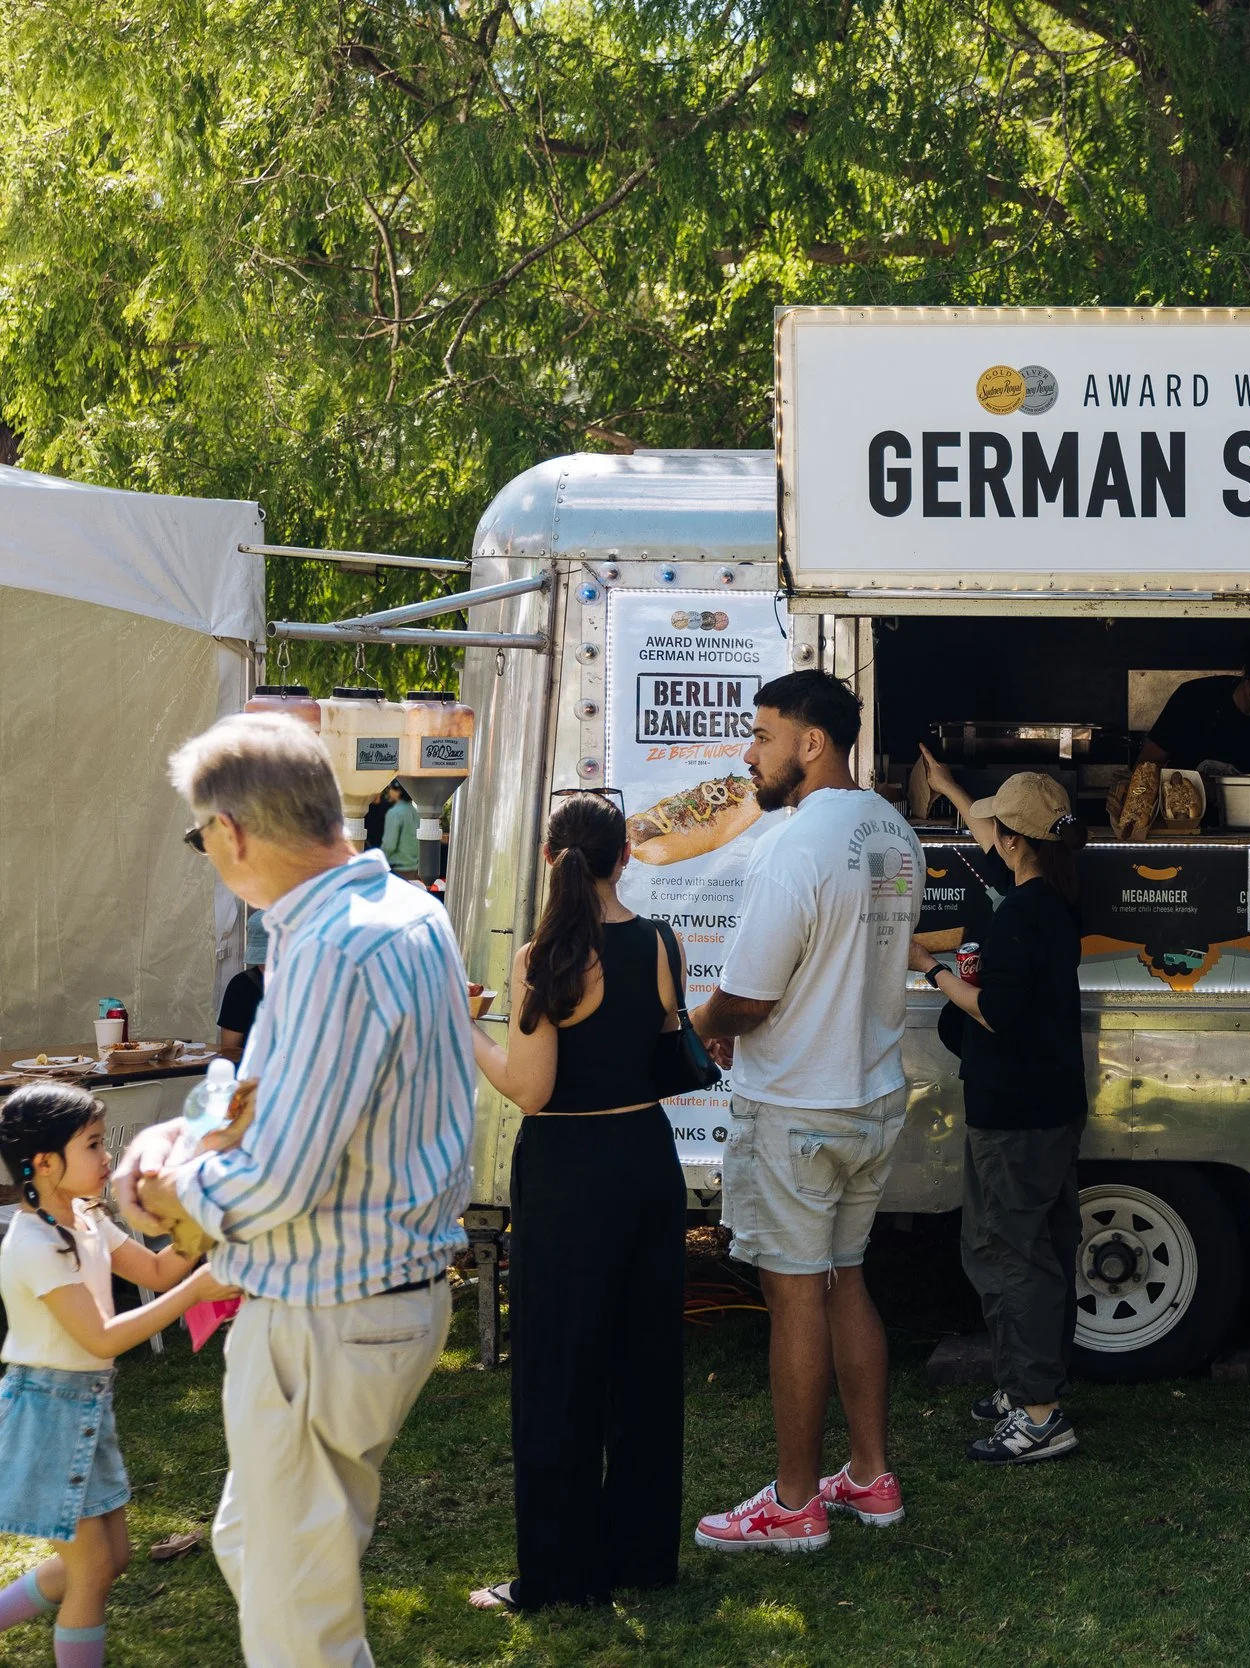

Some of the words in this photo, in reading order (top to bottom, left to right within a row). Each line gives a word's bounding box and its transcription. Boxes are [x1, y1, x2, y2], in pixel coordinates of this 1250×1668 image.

[986, 370, 1012, 381] GOLD
[1022, 369, 1049, 380] ILVER
[979, 384, 1004, 401] Sydney
[1004, 380, 1023, 395] Royal
[1037, 380, 1056, 395] Royal
[1084, 374, 1210, 408] AWARD
[868, 430, 1187, 518] GERMAN
[646, 636, 692, 647] AWARD
[695, 637, 754, 649] WINNING
[639, 650, 694, 661] GERMAN
[698, 651, 760, 663] HOTDOGS
[654, 680, 741, 707] BERLIN
[644, 709, 754, 738] BANGERS
[360, 751, 373, 761] Mild
[374, 751, 398, 761] Mustard
[426, 745, 445, 759] BBQ
[445, 745, 464, 759] Sauce
[646, 748, 666, 761] ZE
[669, 745, 704, 760] BEST
[848, 820, 880, 871] RHODE
[651, 877, 682, 886] served
[685, 877, 705, 886] with
[707, 878, 744, 887] sauerkr
[650, 891, 658, 900] &
[660, 892, 700, 903] crunchy
[701, 894, 735, 902] onions
[923, 888, 966, 901] ATWURST
[1122, 889, 1188, 903] MEGABANGER
[944, 903, 958, 911] mild
[1175, 905, 1198, 914] kransky
[687, 932, 725, 943] classic
[877, 926, 894, 936] LUB
[687, 964, 724, 977] NSKY
[660, 1096, 707, 1106] nkfurter
[709, 1097, 719, 1107] in
[722, 1100, 728, 1108] a
[674, 1127, 706, 1140] NKS
[714, 1129, 725, 1139] $4
